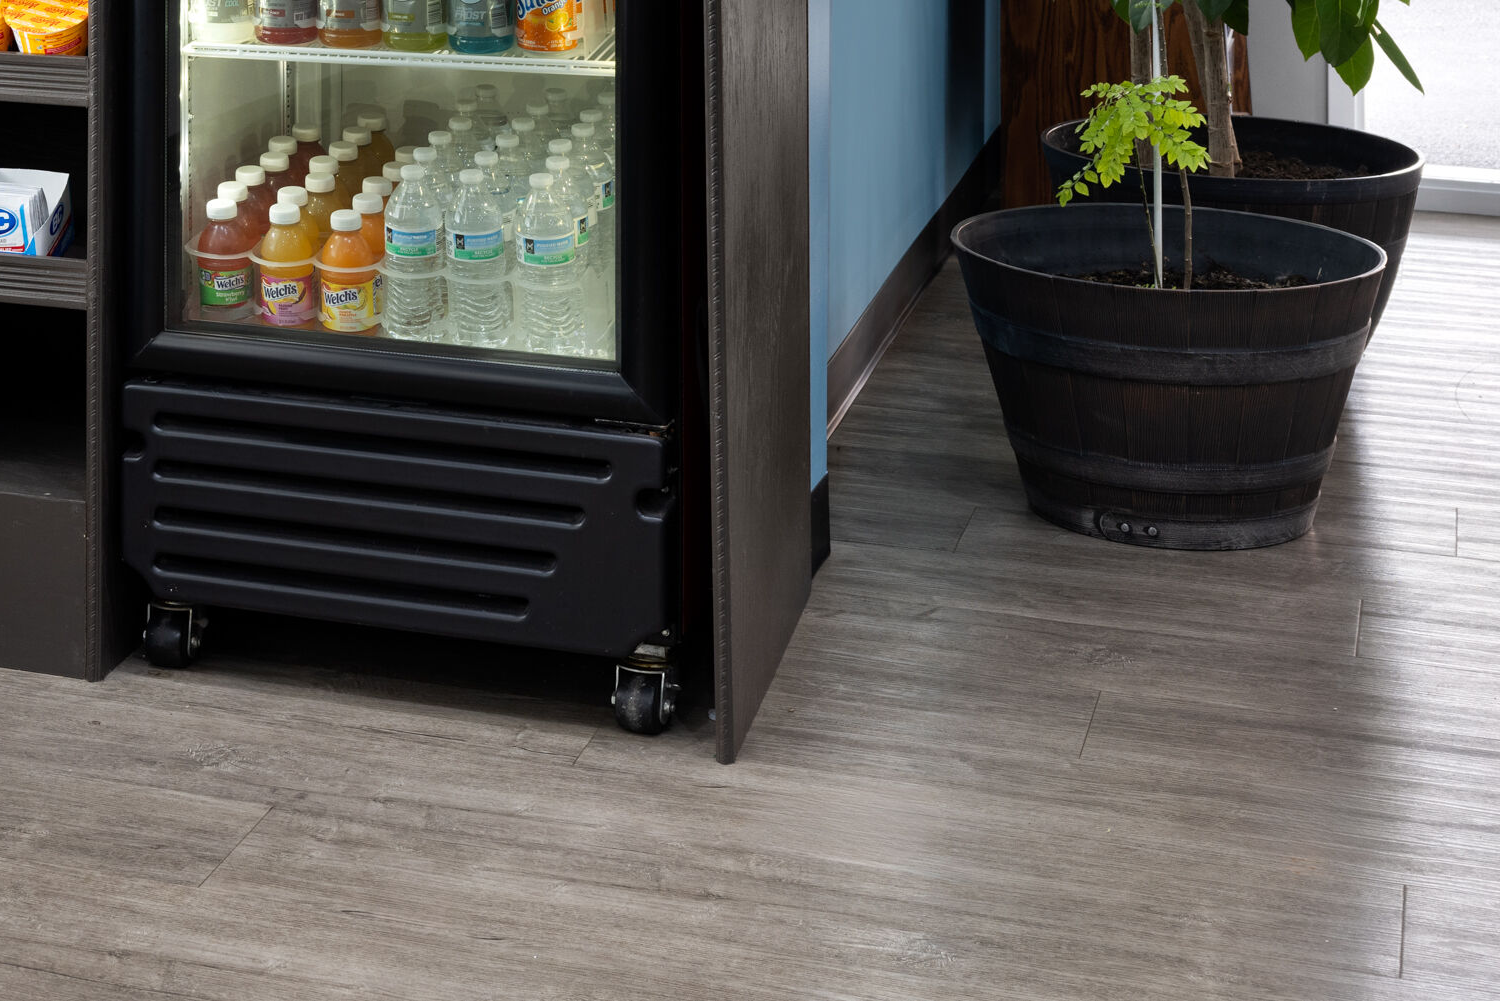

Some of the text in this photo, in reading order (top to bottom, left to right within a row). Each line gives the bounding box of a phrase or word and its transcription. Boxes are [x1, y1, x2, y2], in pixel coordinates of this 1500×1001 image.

[454, 9, 486, 20] FROST
[216, 276, 245, 290] Welch's
[264, 284, 298, 300] Welch's
[324, 290, 358, 306] Welch's
